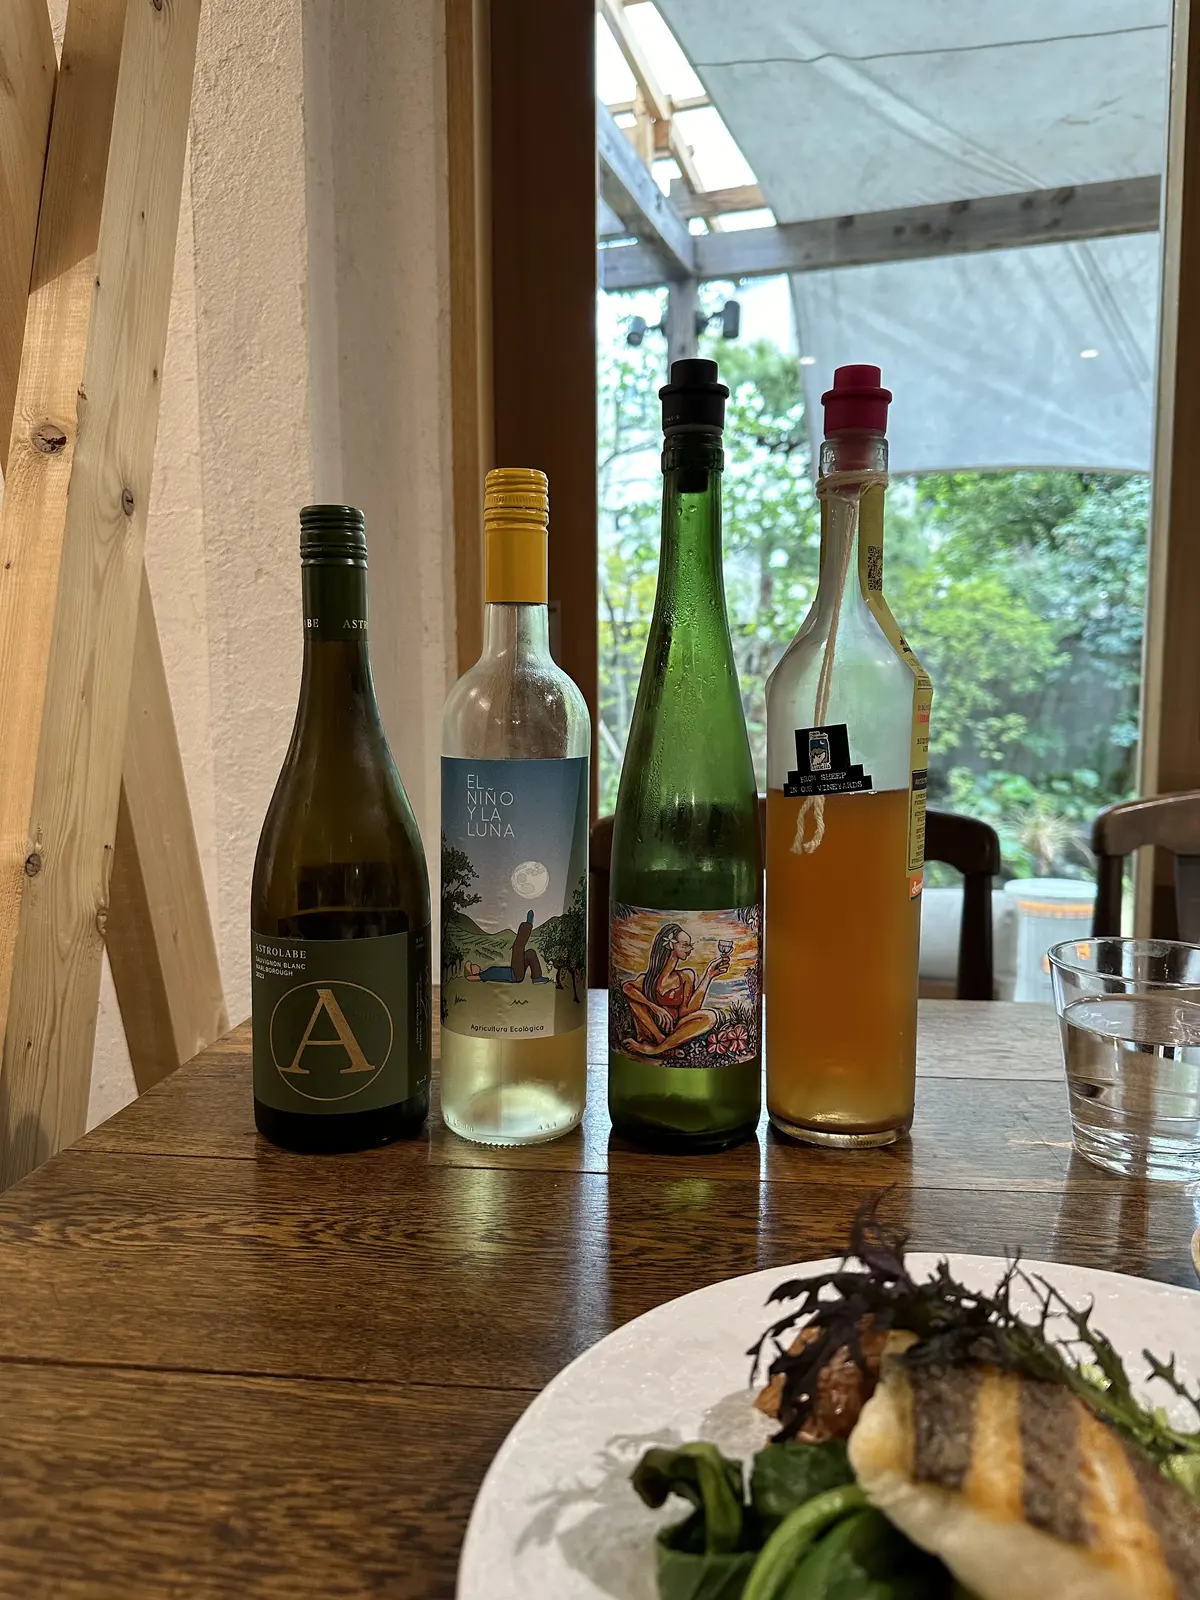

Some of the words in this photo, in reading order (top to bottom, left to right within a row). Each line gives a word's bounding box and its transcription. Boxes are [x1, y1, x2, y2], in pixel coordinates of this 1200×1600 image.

[467, 774, 485, 790] EL
[820, 771, 847, 781] SHEEP
[817, 780, 863, 792] VINEYARDS
[467, 787, 515, 806] NIÑO
[467, 806, 477, 821] Y
[481, 807, 502, 822] LA
[467, 822, 515, 838] LUNA
[255, 943, 307, 959] ASTROLABE
[255, 963, 294, 977] MARLBOROUGH
[283, 962, 306, 970] BLANC
[470, 1023, 508, 1033] Agricultura
[510, 1024, 545, 1033] Ecológica
